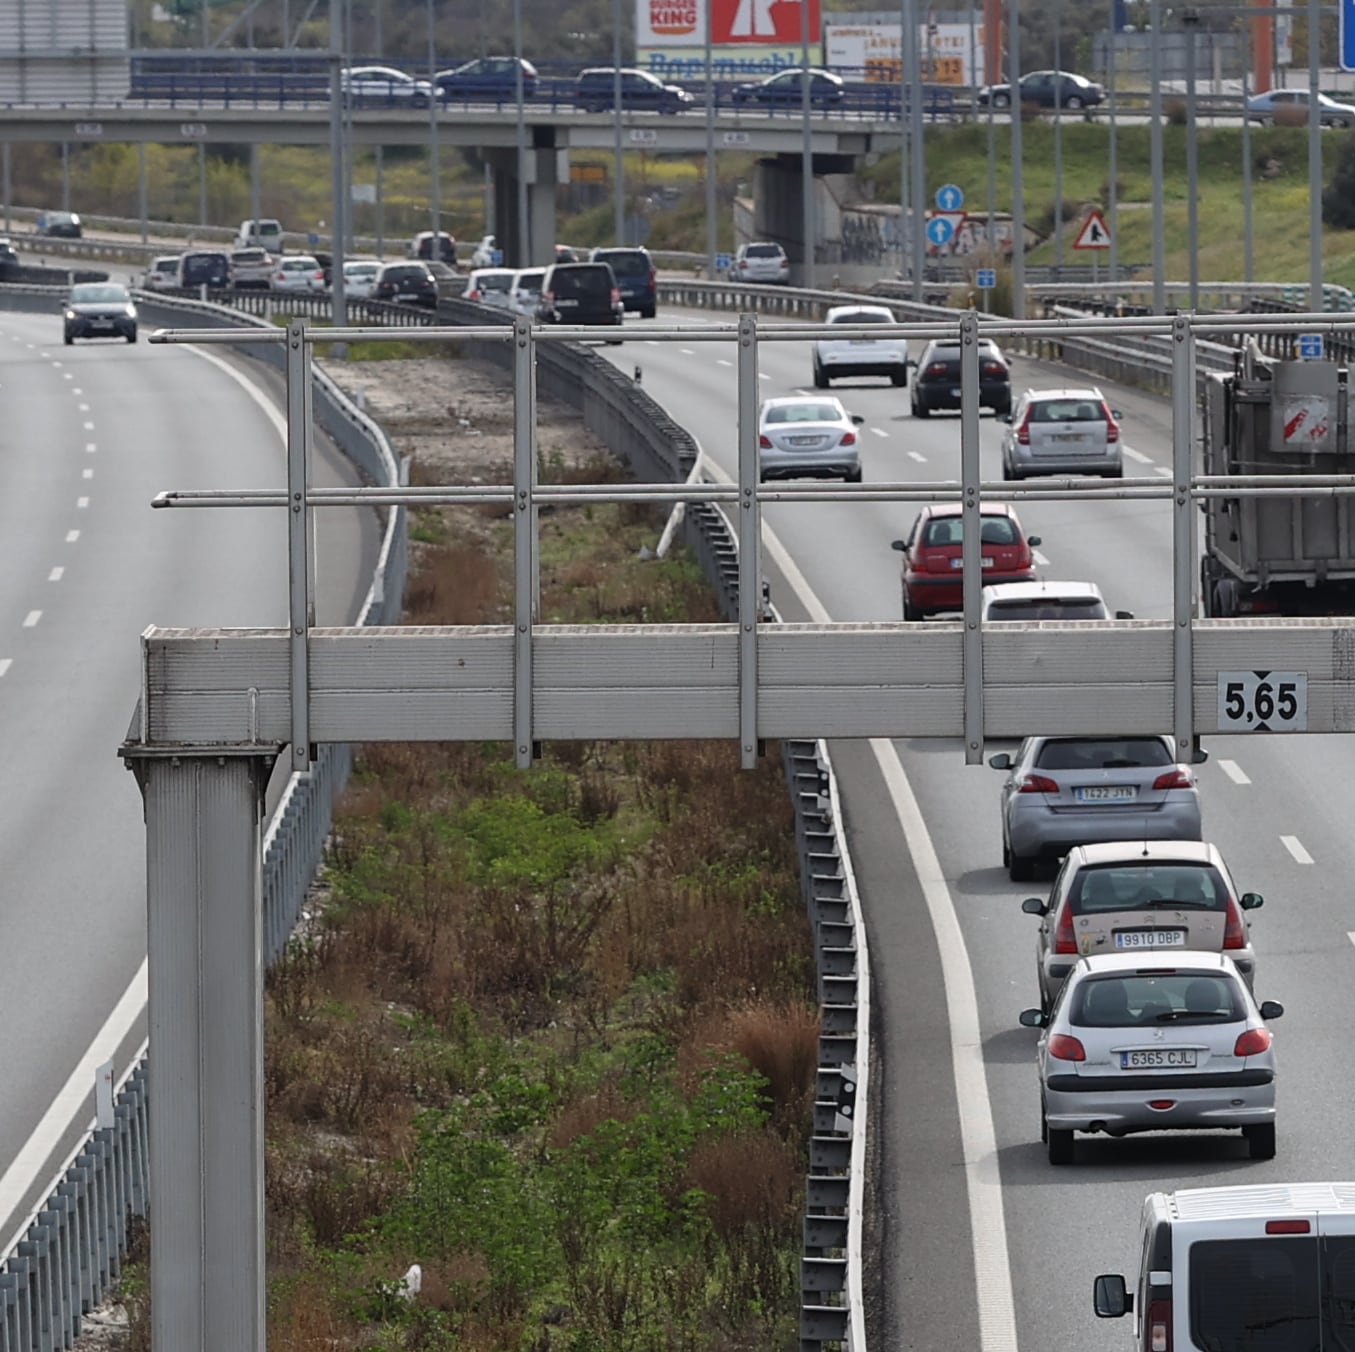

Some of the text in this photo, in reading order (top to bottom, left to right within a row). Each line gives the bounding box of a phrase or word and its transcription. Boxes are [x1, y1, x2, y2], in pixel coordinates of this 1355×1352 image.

[650, 10, 697, 25] KING
[1225, 682, 1298, 723] 5,65
[1124, 933, 1155, 946] 9910
[1131, 1052, 1191, 1065] 6365 CJL
